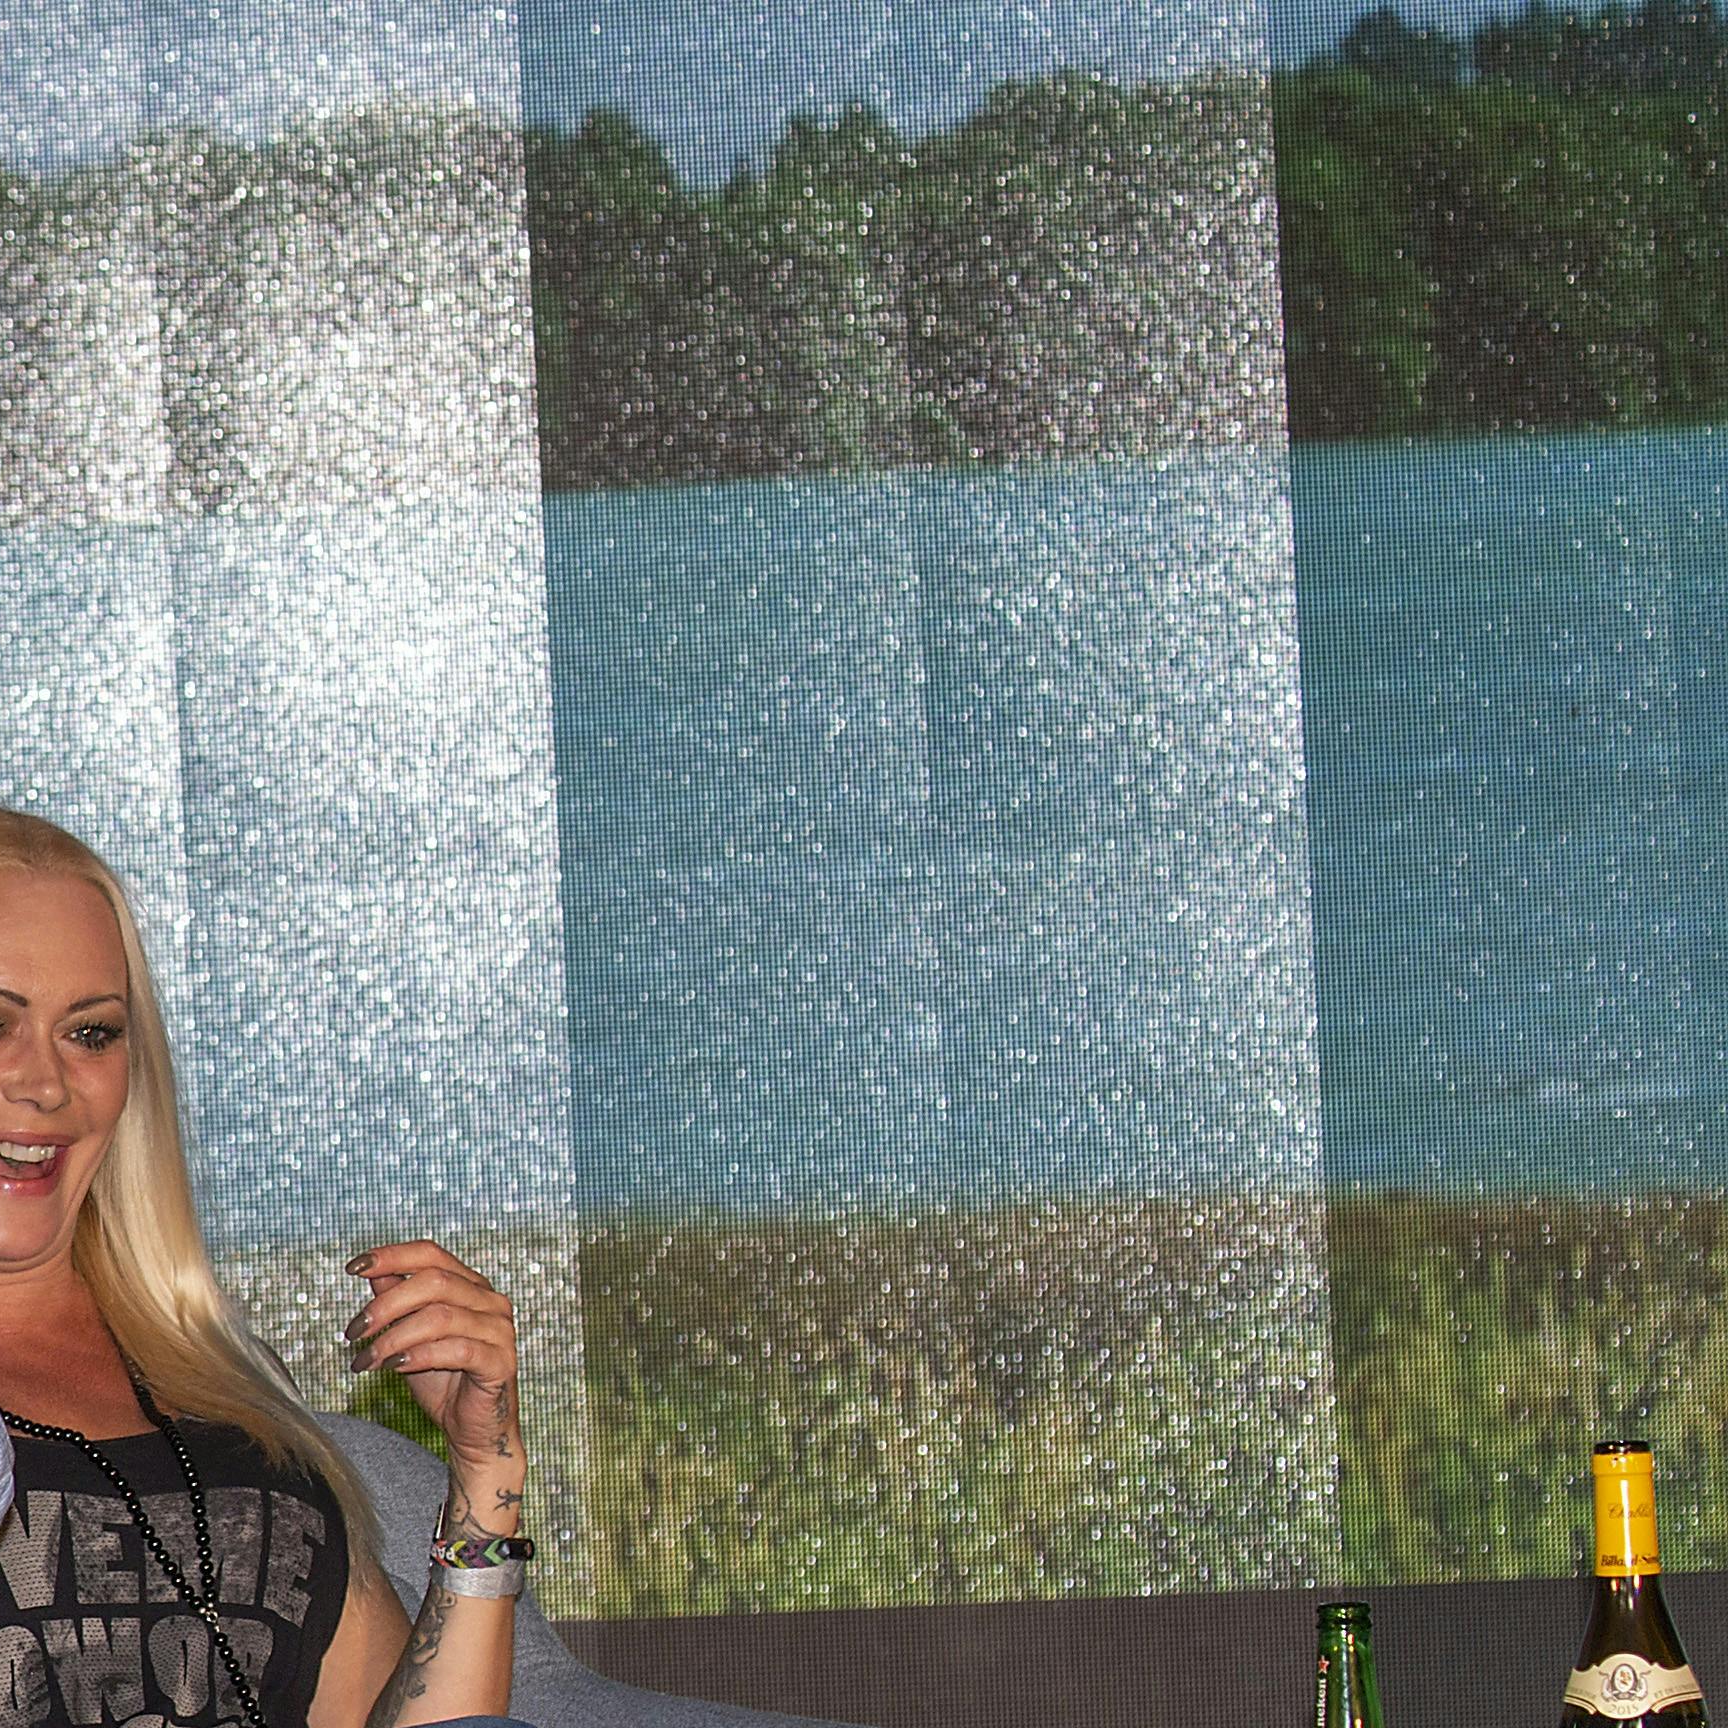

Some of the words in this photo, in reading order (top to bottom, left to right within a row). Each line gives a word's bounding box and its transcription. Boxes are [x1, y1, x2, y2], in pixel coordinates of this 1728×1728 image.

[144, 1486, 326, 1628] ME
[148, 1614, 275, 1720] OR
[1608, 1703, 1639, 1715] 2015
